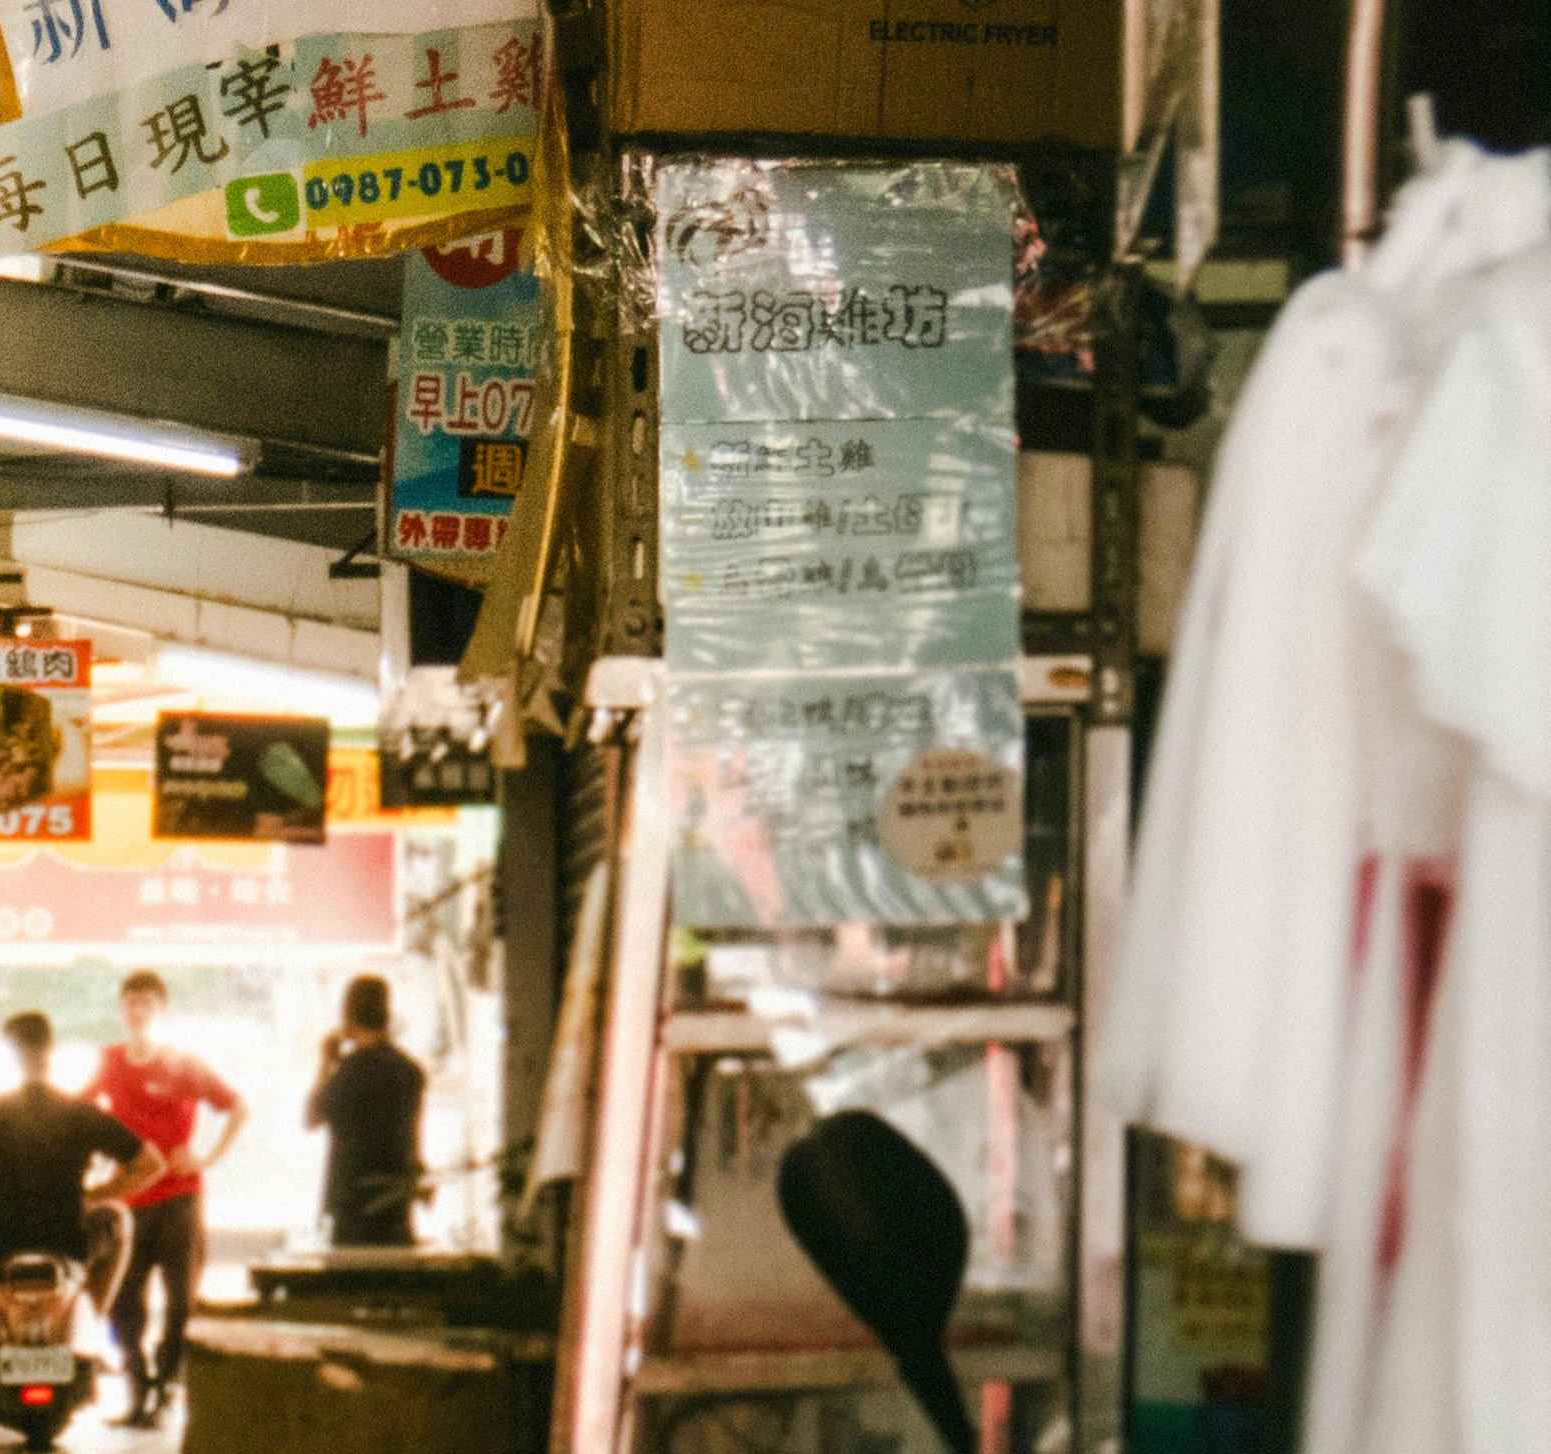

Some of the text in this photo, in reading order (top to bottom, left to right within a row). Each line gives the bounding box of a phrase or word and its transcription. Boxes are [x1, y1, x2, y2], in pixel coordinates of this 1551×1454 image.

[870, 20, 1058, 46] ELECTRIC FRYER
[414, 322, 536, 364] 營業時
